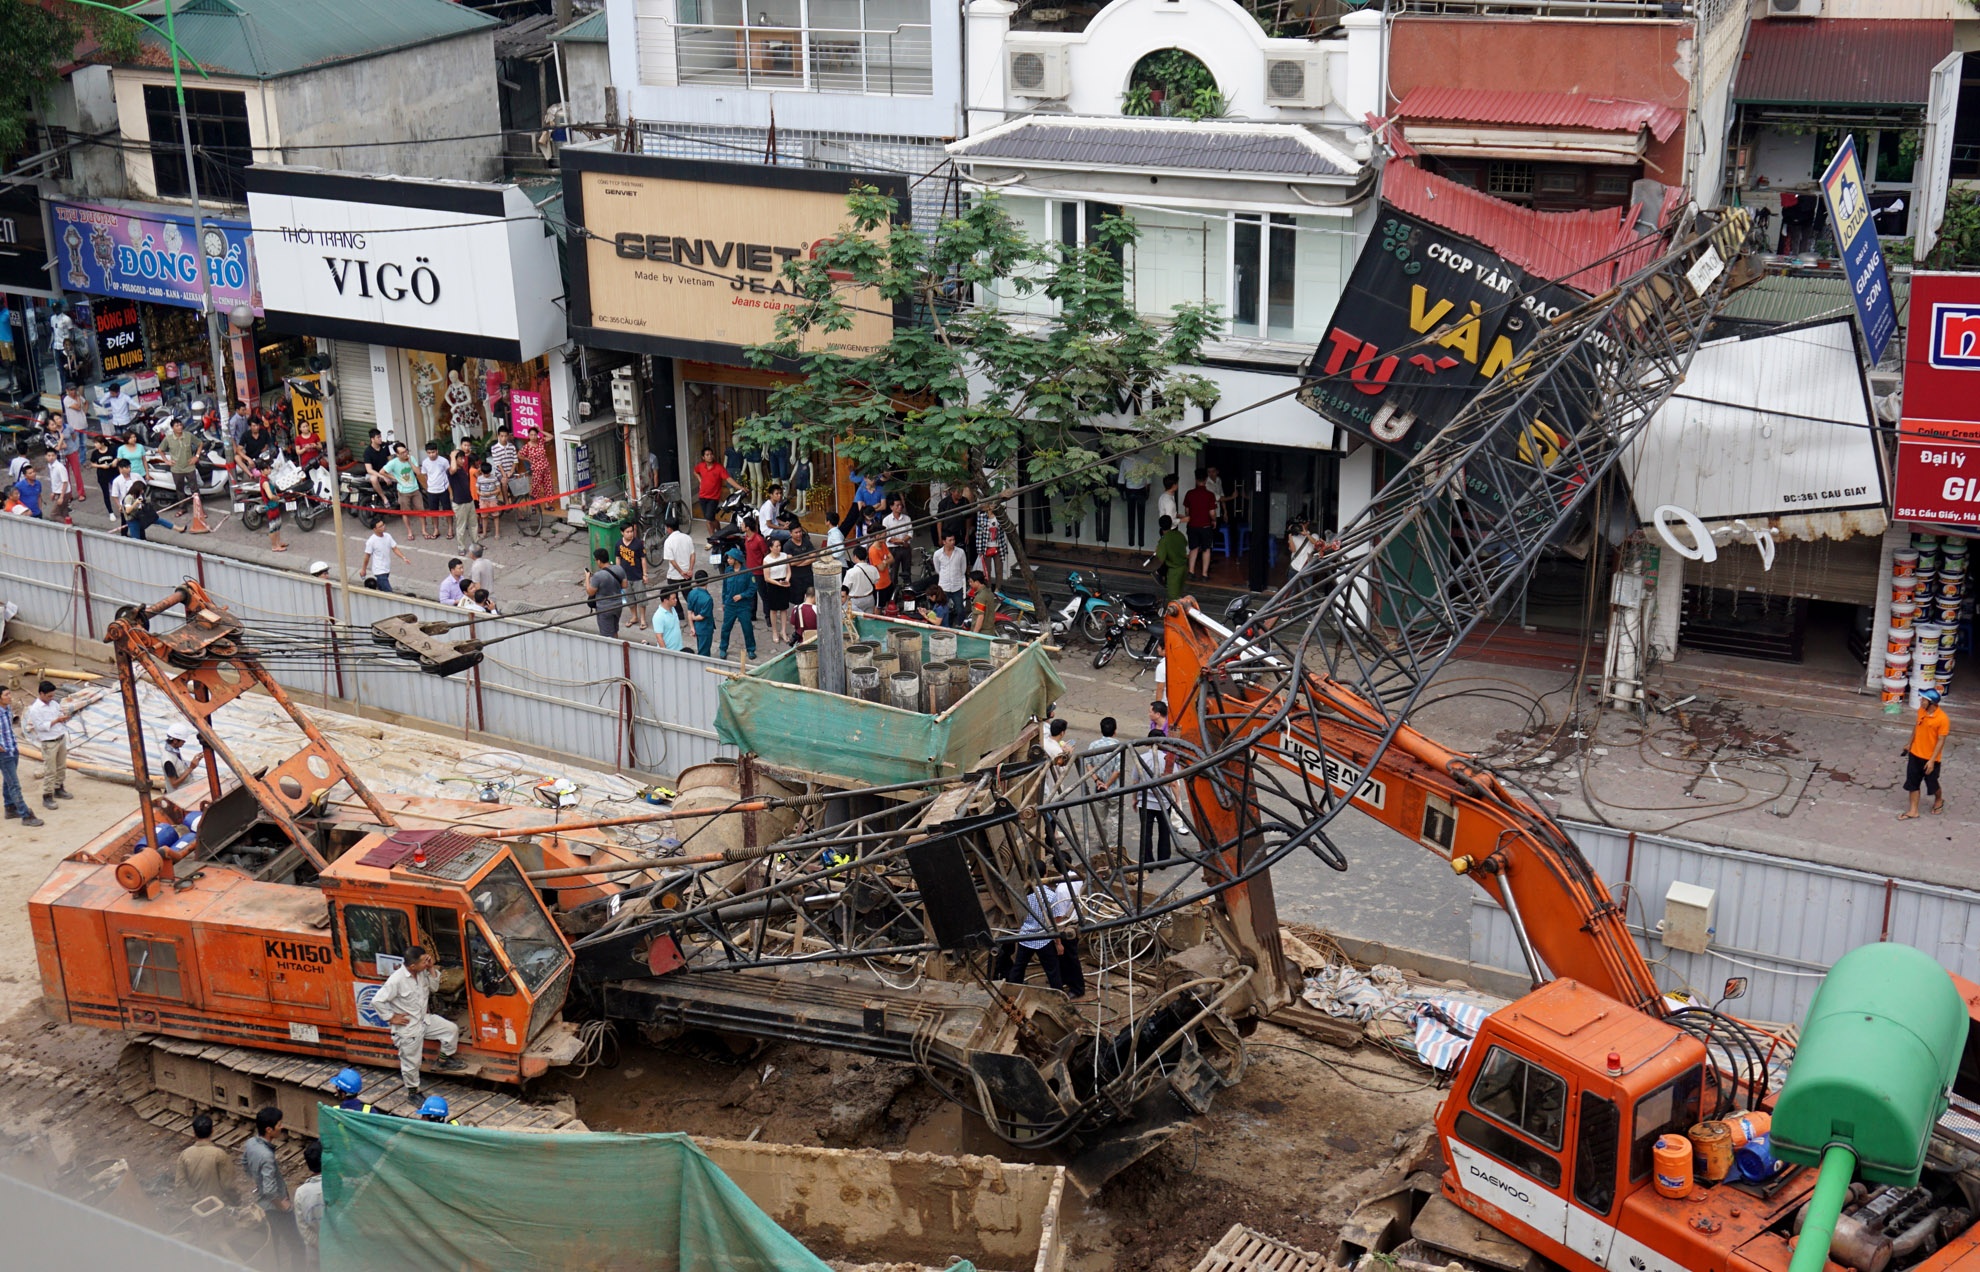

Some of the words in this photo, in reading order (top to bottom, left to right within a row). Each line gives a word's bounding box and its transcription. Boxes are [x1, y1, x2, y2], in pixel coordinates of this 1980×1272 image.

[605, 189, 638, 197] GENVIET
[1844, 204, 1867, 246] JOTUN
[119, 234, 197, 282] ĐỒNG
[1427, 243, 1473, 274] CTCP
[322, 256, 441, 305] VIGÖ
[635, 270, 659, 281] Made
[662, 273, 673, 284] by
[678, 275, 715, 287] Vietnam
[1856, 251, 1880, 295] GIANG
[732, 296, 761, 308] Jeans
[106, 331, 135, 349] ĐIỆN
[104, 355, 119, 371] GIA
[373, 365, 385, 373] 353
[513, 394, 539, 406] SALE
[1920, 450, 1947, 467] Đại
[1951, 452, 1966, 468] lý
[1942, 477, 1980, 502] GI
[1898, 508, 1917, 517] 361
[265, 939, 331, 965] KH150
[276, 960, 325, 974] HITACHI
[1470, 1165, 1530, 1203] DAEWOO
